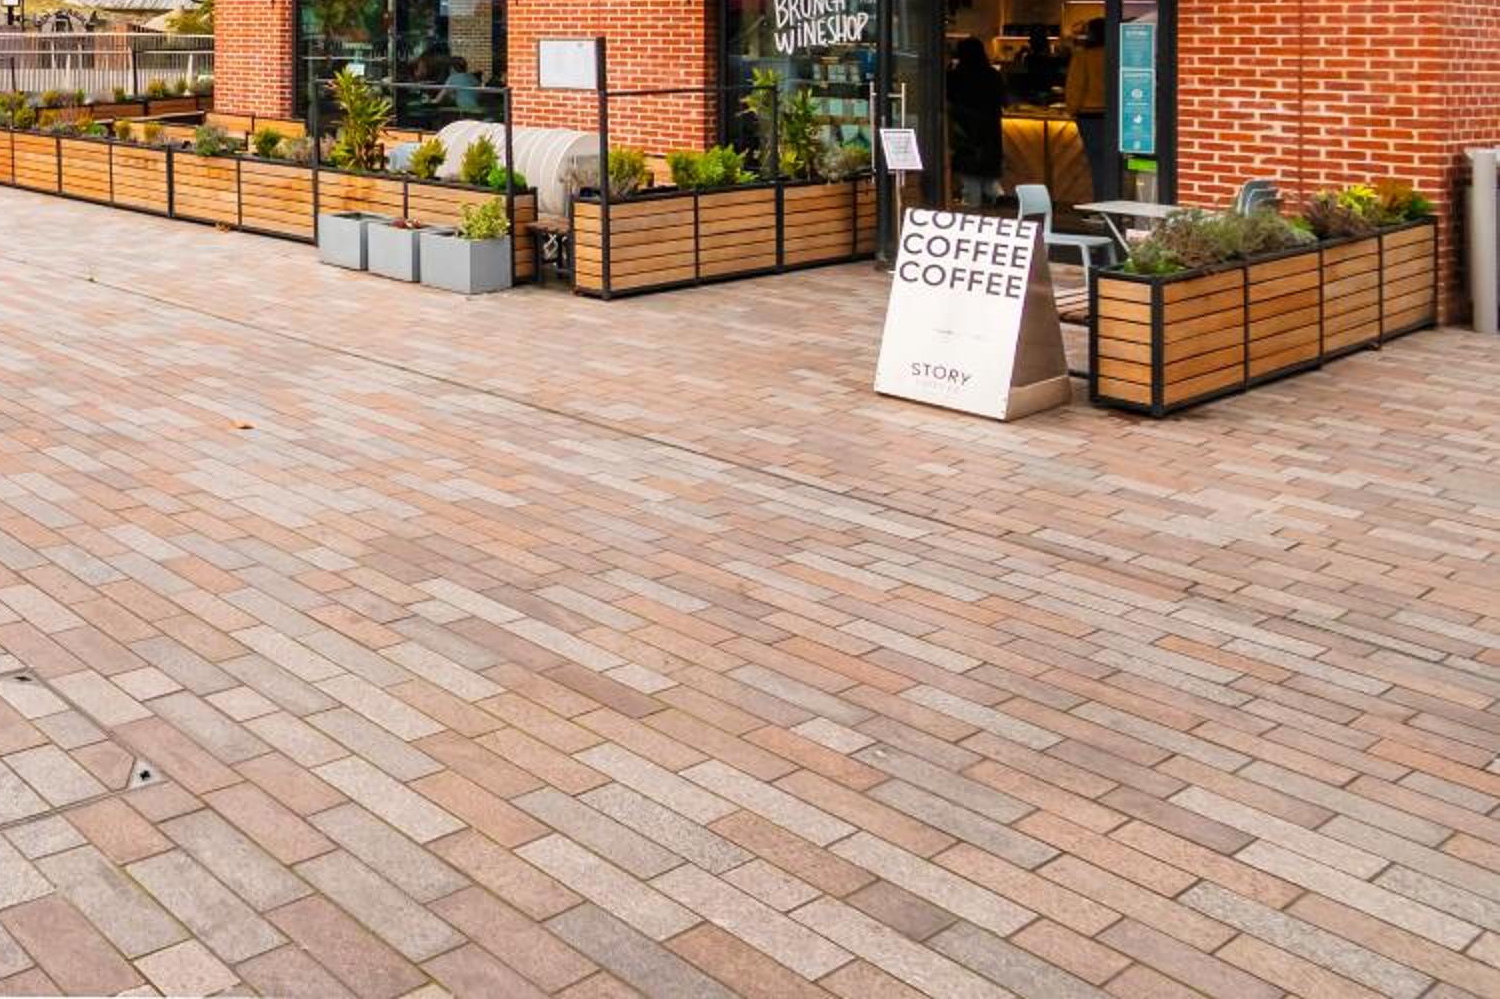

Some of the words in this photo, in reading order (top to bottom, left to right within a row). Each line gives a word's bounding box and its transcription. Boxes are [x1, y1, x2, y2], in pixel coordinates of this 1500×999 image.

[903, 232, 1030, 270] COFFEE
[900, 260, 1023, 299] COFFEE
[911, 362, 973, 386] STORY
